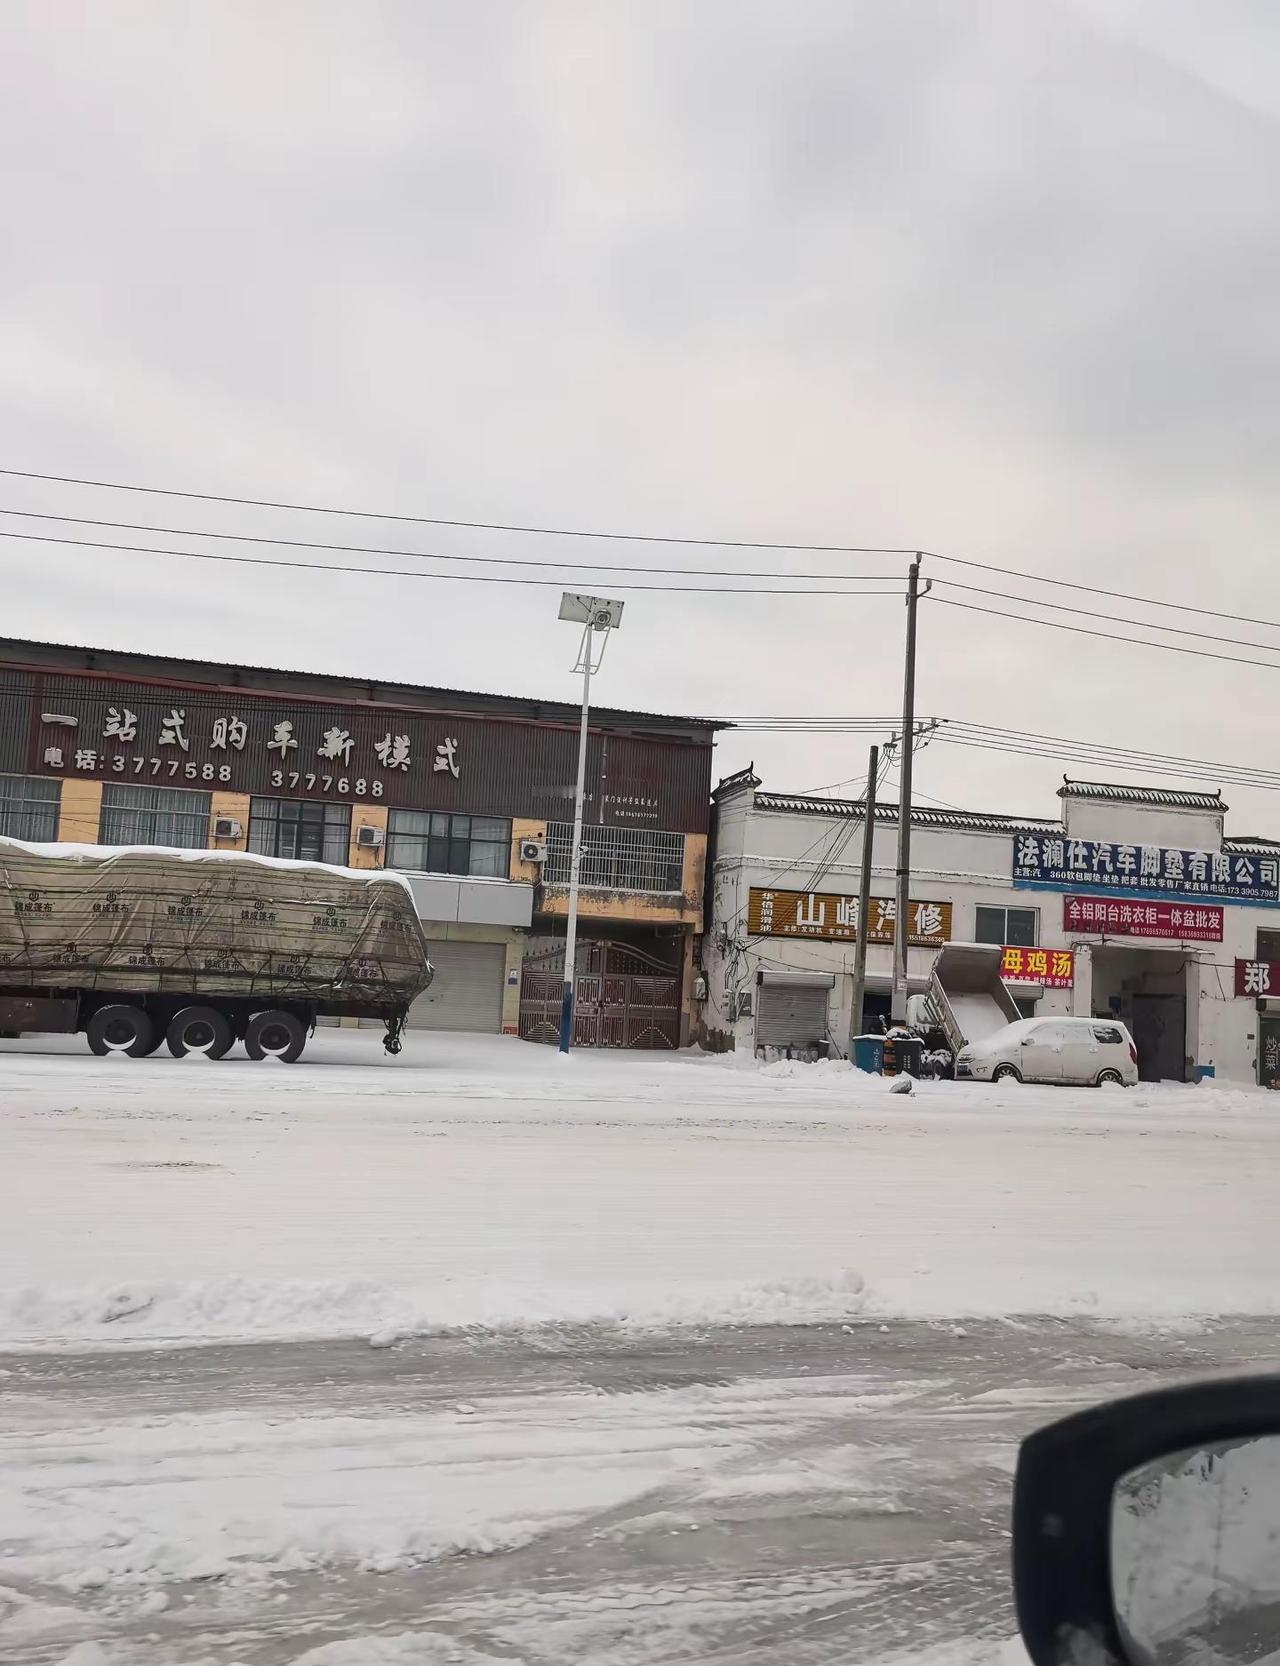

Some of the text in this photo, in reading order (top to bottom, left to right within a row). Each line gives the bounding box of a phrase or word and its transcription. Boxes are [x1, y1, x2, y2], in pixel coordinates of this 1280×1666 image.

[40, 706, 462, 779] 一站式购车新模式
[271, 769, 386, 798] 3777688
[1017, 835, 1278, 887] 法澜仕汽车脚垫有限公司
[1069, 901, 1221, 929] 全铝阳台洗衣柜一体盆批发
[1002, 948, 1072, 978] 母鸡汤
[1244, 961, 1271, 994] 郑
